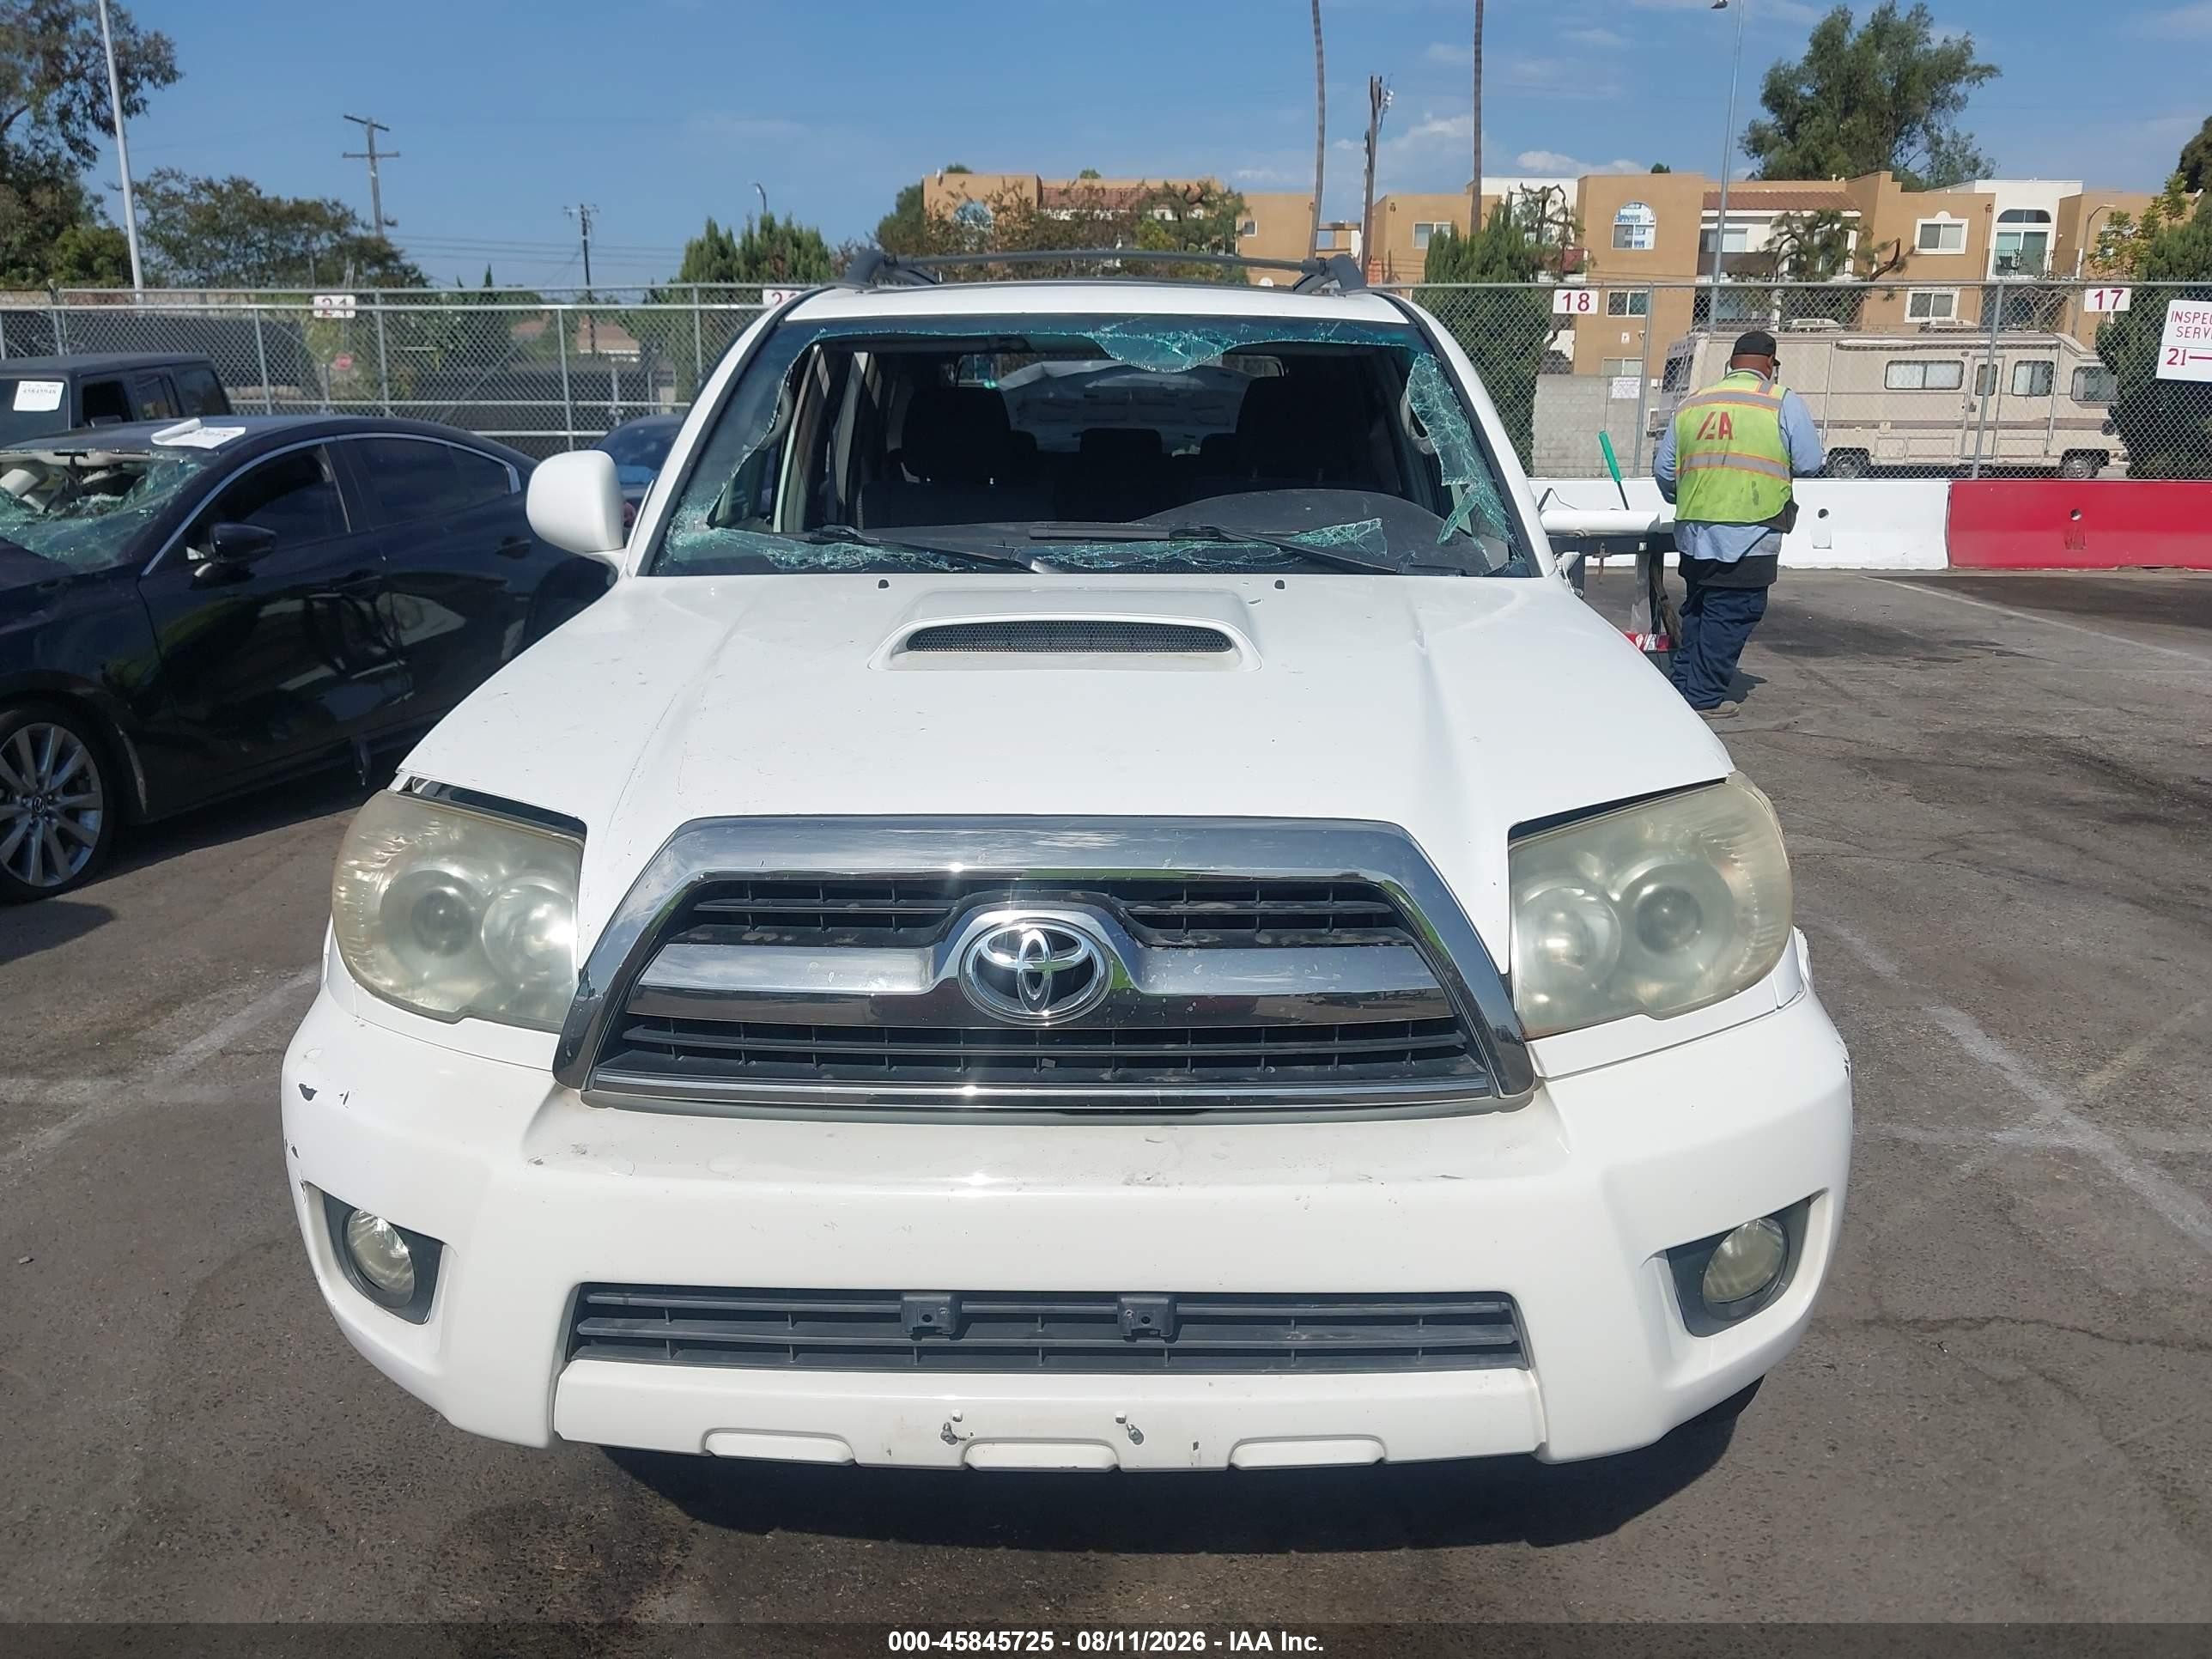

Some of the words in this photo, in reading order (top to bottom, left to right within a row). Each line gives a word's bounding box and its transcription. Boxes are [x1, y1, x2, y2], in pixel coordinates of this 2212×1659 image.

[1562, 292, 1590, 312] 18
[2094, 289, 2124, 310] 17
[2170, 310, 2212, 324] INSPE
[2176, 325, 2212, 340] SERV
[2166, 347, 2187, 366] 21
